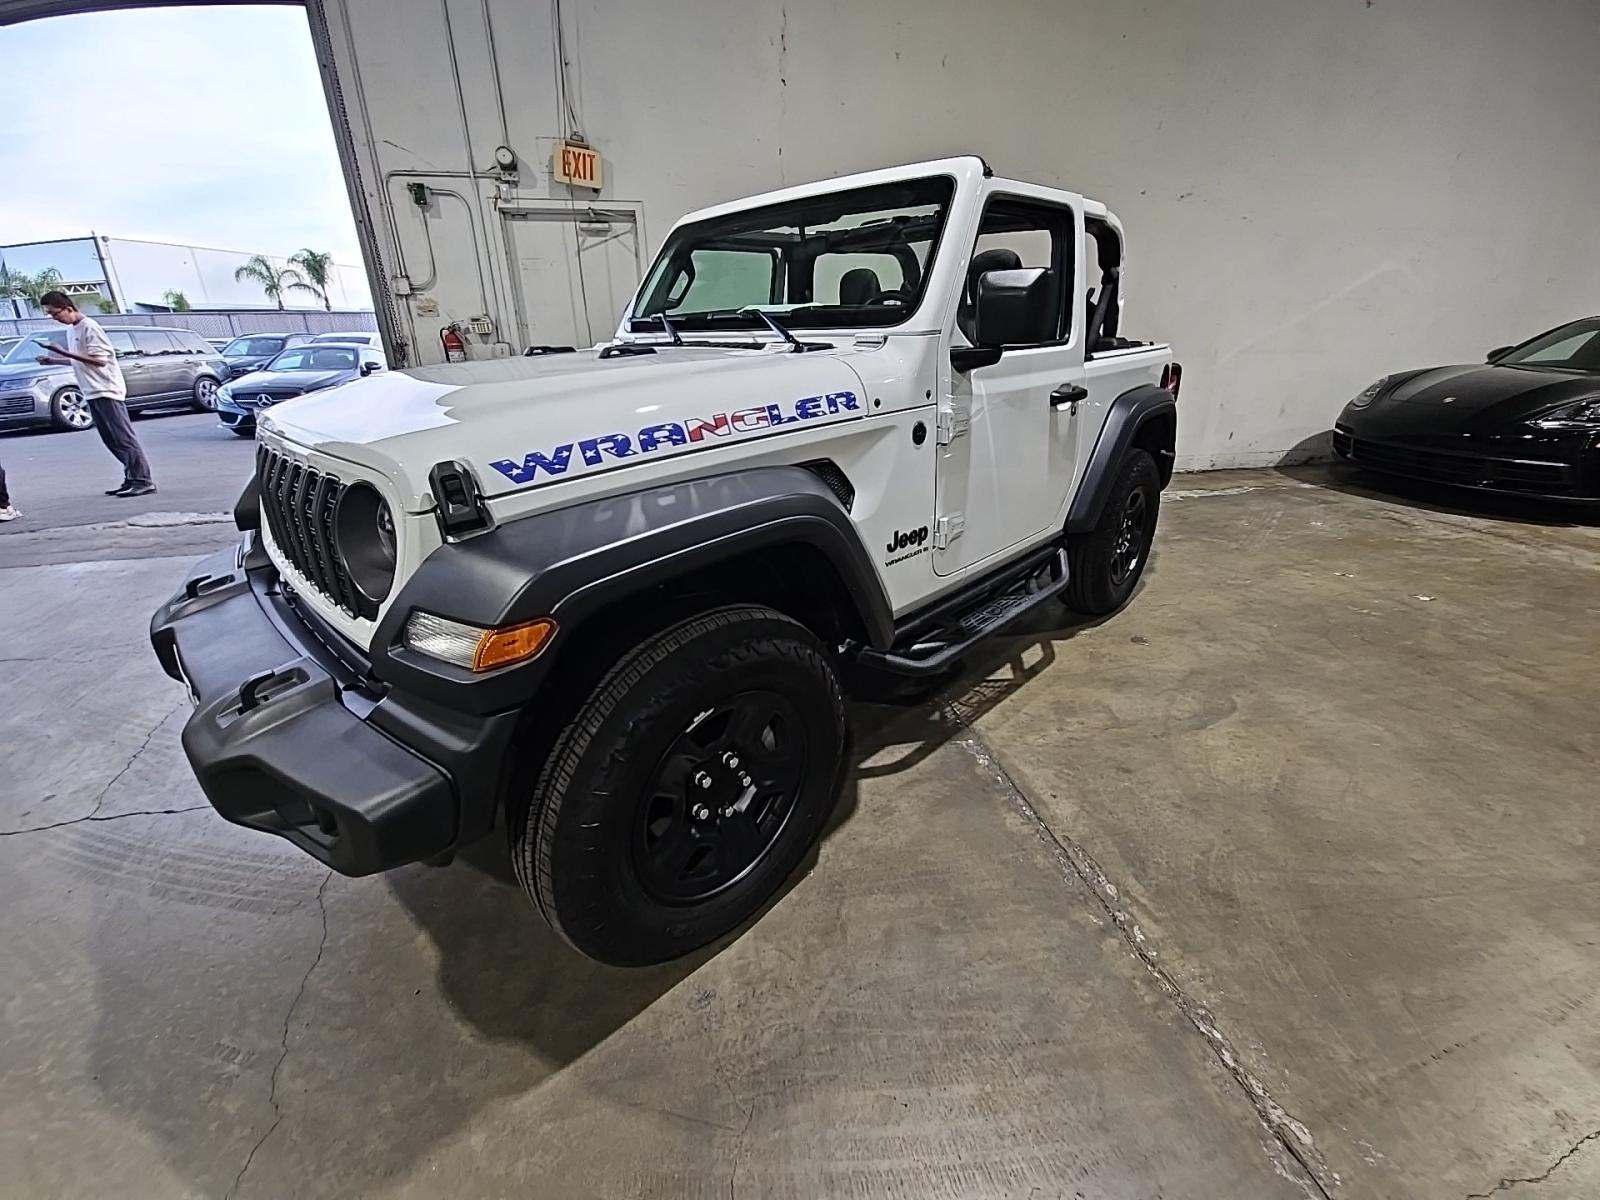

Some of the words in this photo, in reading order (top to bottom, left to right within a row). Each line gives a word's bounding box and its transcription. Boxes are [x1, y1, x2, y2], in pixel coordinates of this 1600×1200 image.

[561, 149, 596, 181] EXIT
[489, 391, 860, 485] WRANGLER
[886, 525, 929, 553] Jeep
